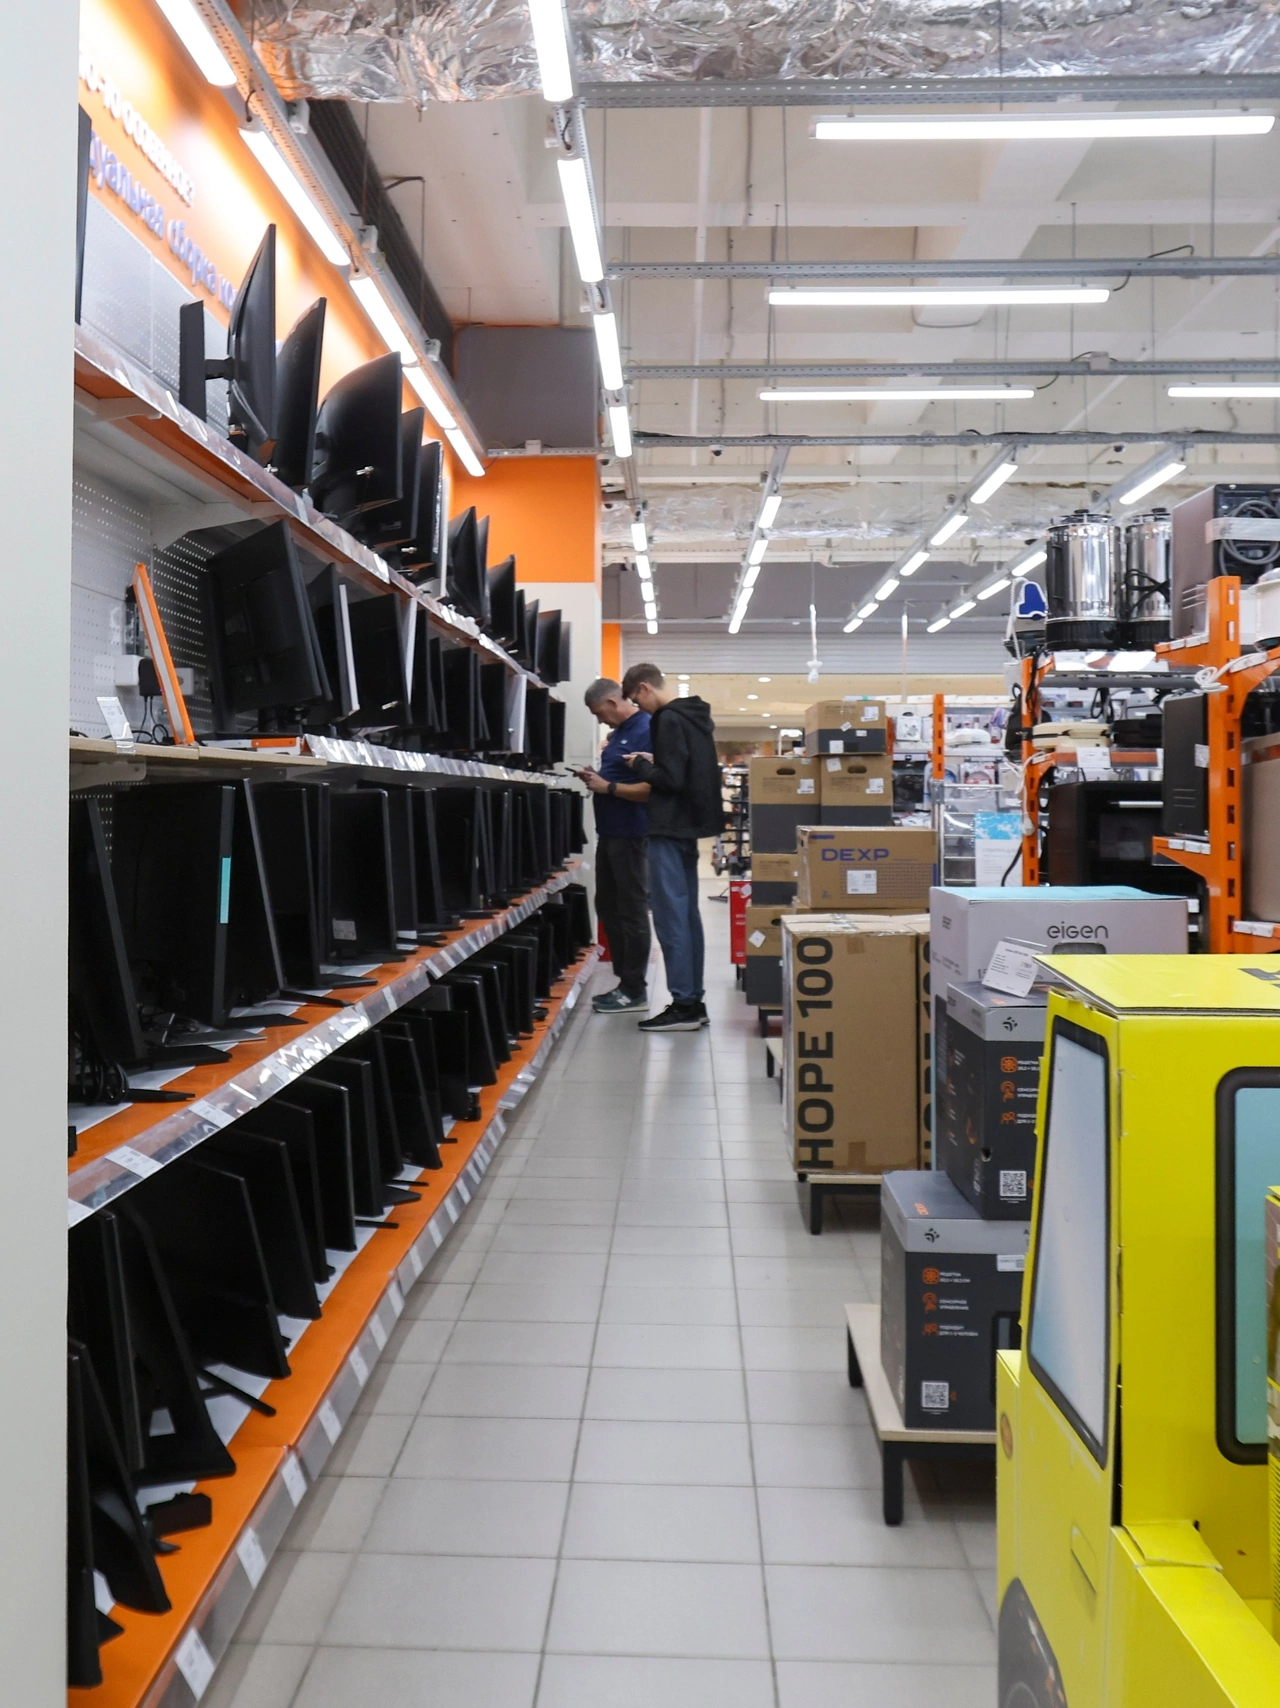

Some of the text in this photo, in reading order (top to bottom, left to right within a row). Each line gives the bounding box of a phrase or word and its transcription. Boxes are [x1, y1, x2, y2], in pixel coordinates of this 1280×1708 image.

[167, 219, 217, 296] сборка
[821, 848, 890, 862] DEXP
[796, 937, 834, 1169] HOPE 100
